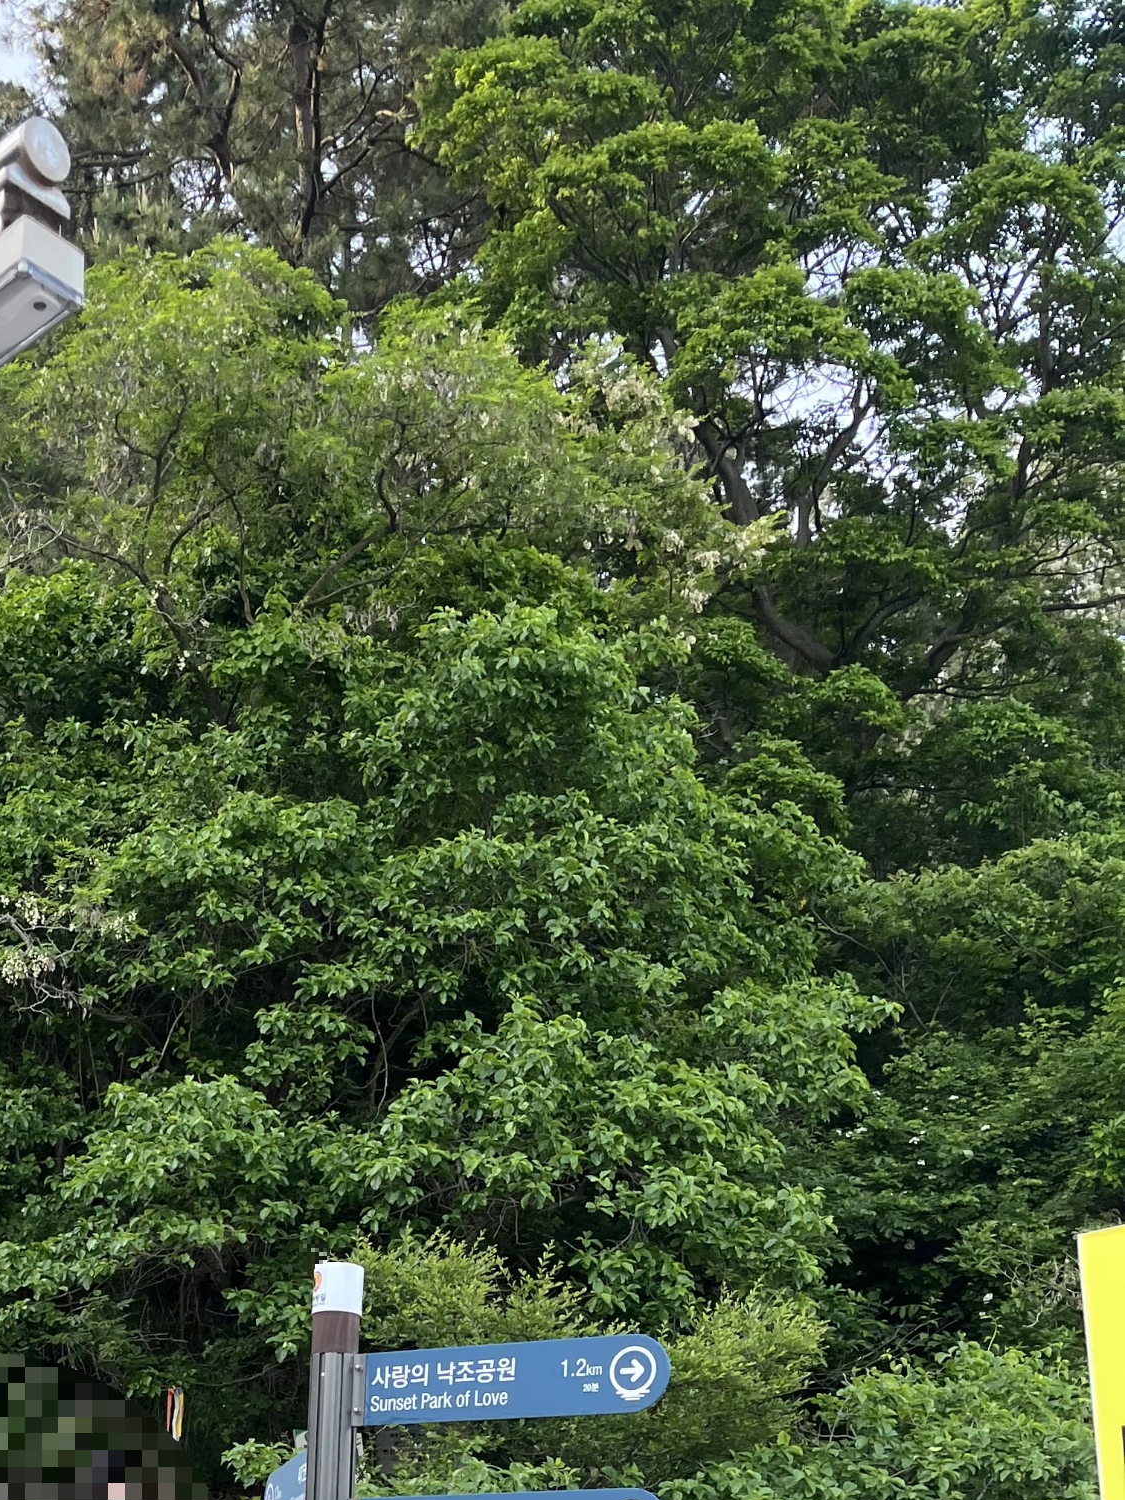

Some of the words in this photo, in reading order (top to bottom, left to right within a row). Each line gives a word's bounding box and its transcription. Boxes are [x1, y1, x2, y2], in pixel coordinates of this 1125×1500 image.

[371, 1363, 428, 1389] 사랑의
[436, 1357, 516, 1385] 낙조공원
[561, 1358, 602, 1378] 1.2km
[370, 1394, 417, 1412] Sunset
[421, 1392, 452, 1410] Park
[456, 1390, 470, 1407] of
[474, 1389, 508, 1407] Love
